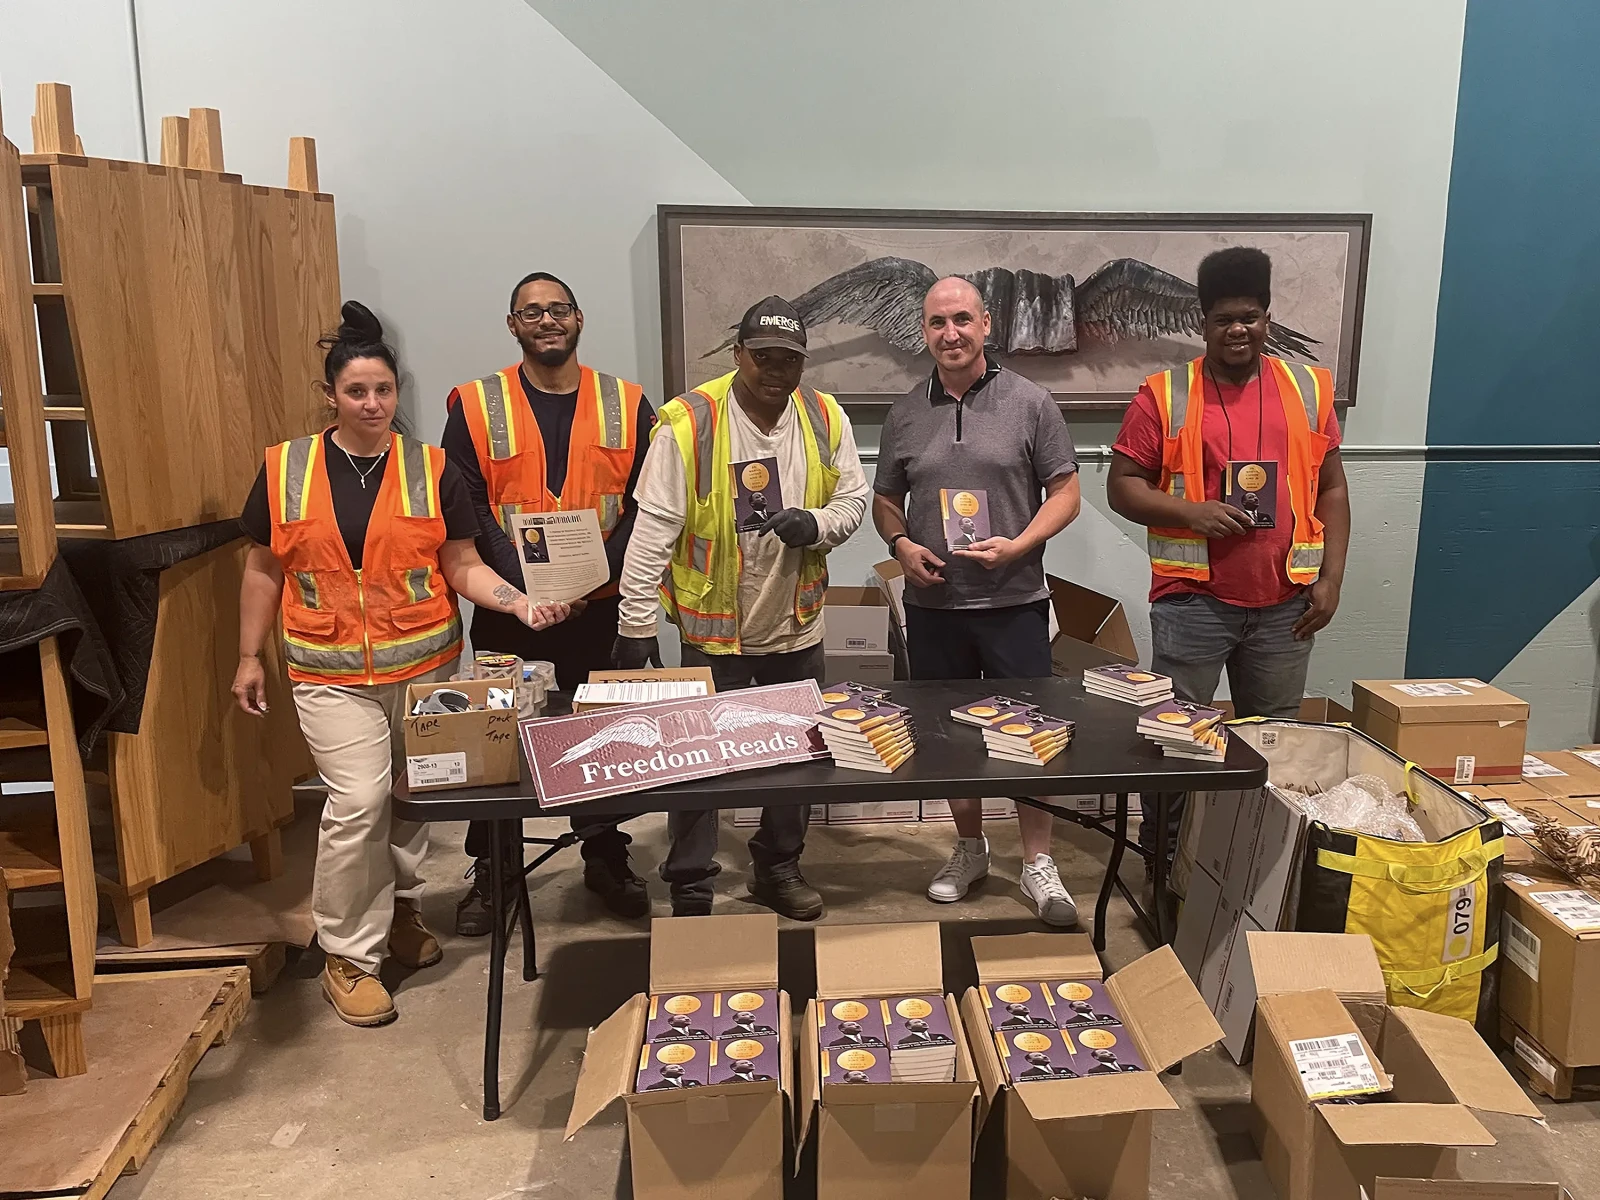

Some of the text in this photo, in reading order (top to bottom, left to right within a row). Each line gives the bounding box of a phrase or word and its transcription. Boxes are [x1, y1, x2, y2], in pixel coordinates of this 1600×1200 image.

[759, 315, 801, 331] EMERGE
[580, 731, 799, 785] Freedom Reads
[1453, 897, 1472, 935] 079
